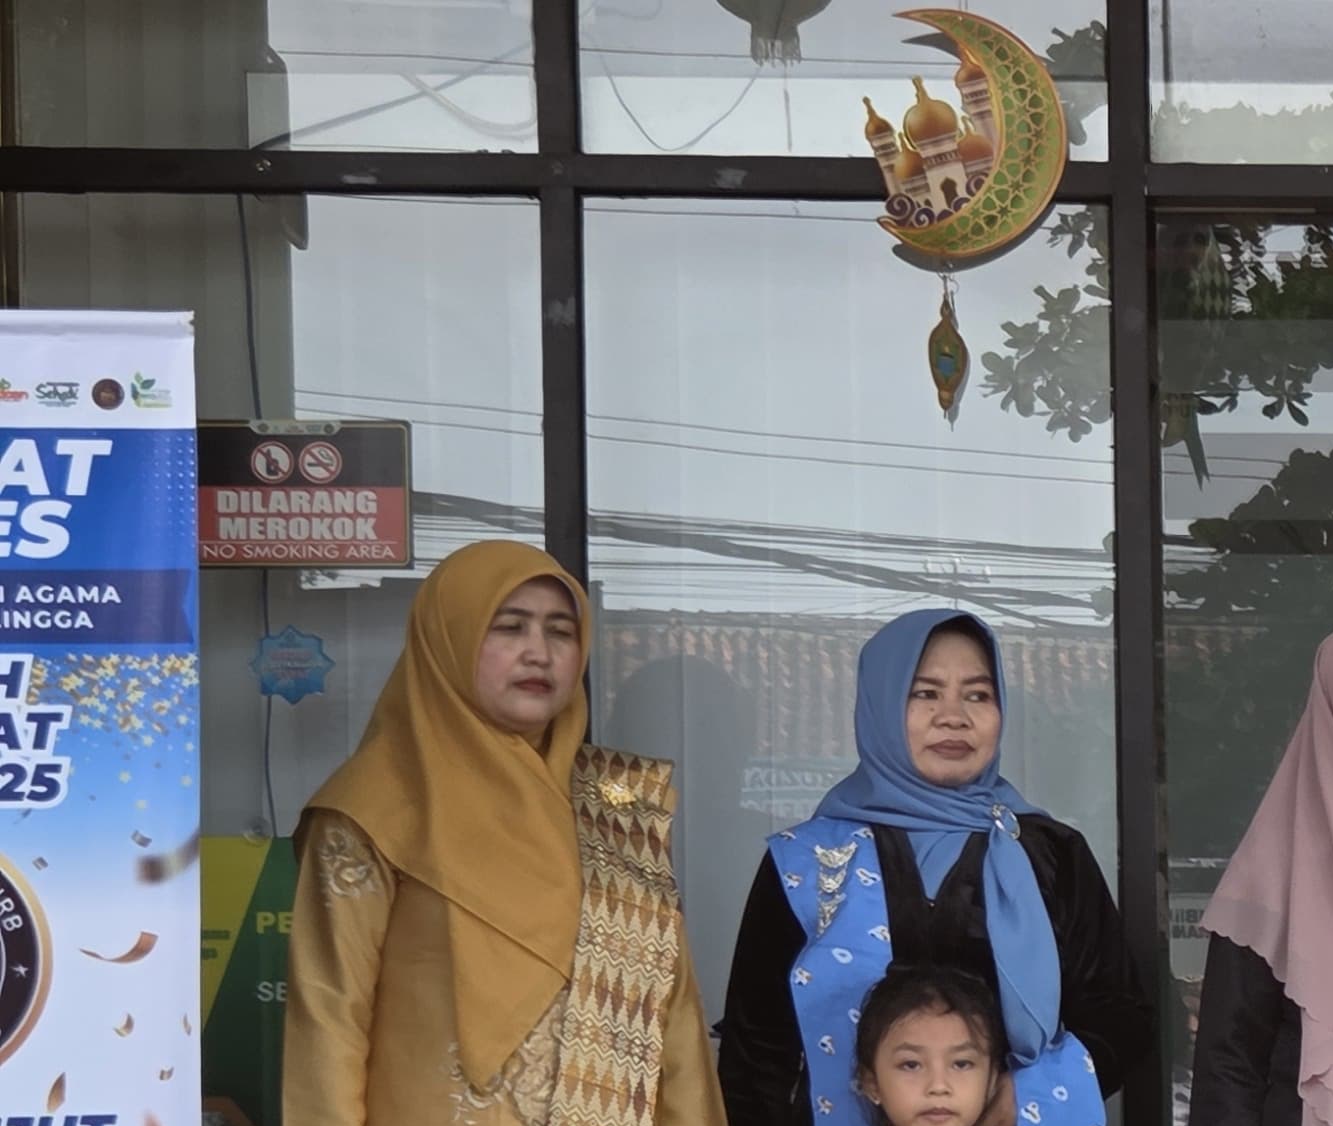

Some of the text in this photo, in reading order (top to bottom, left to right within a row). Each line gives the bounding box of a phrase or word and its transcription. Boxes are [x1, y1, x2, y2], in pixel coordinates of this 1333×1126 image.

[217, 490, 377, 513] DILARANG
[219, 517, 377, 540] MEROKOK
[203, 544, 395, 559] NO SMOKING AREA
[16, 585, 121, 604] AGAMA
[0, 611, 94, 629] INGGA
